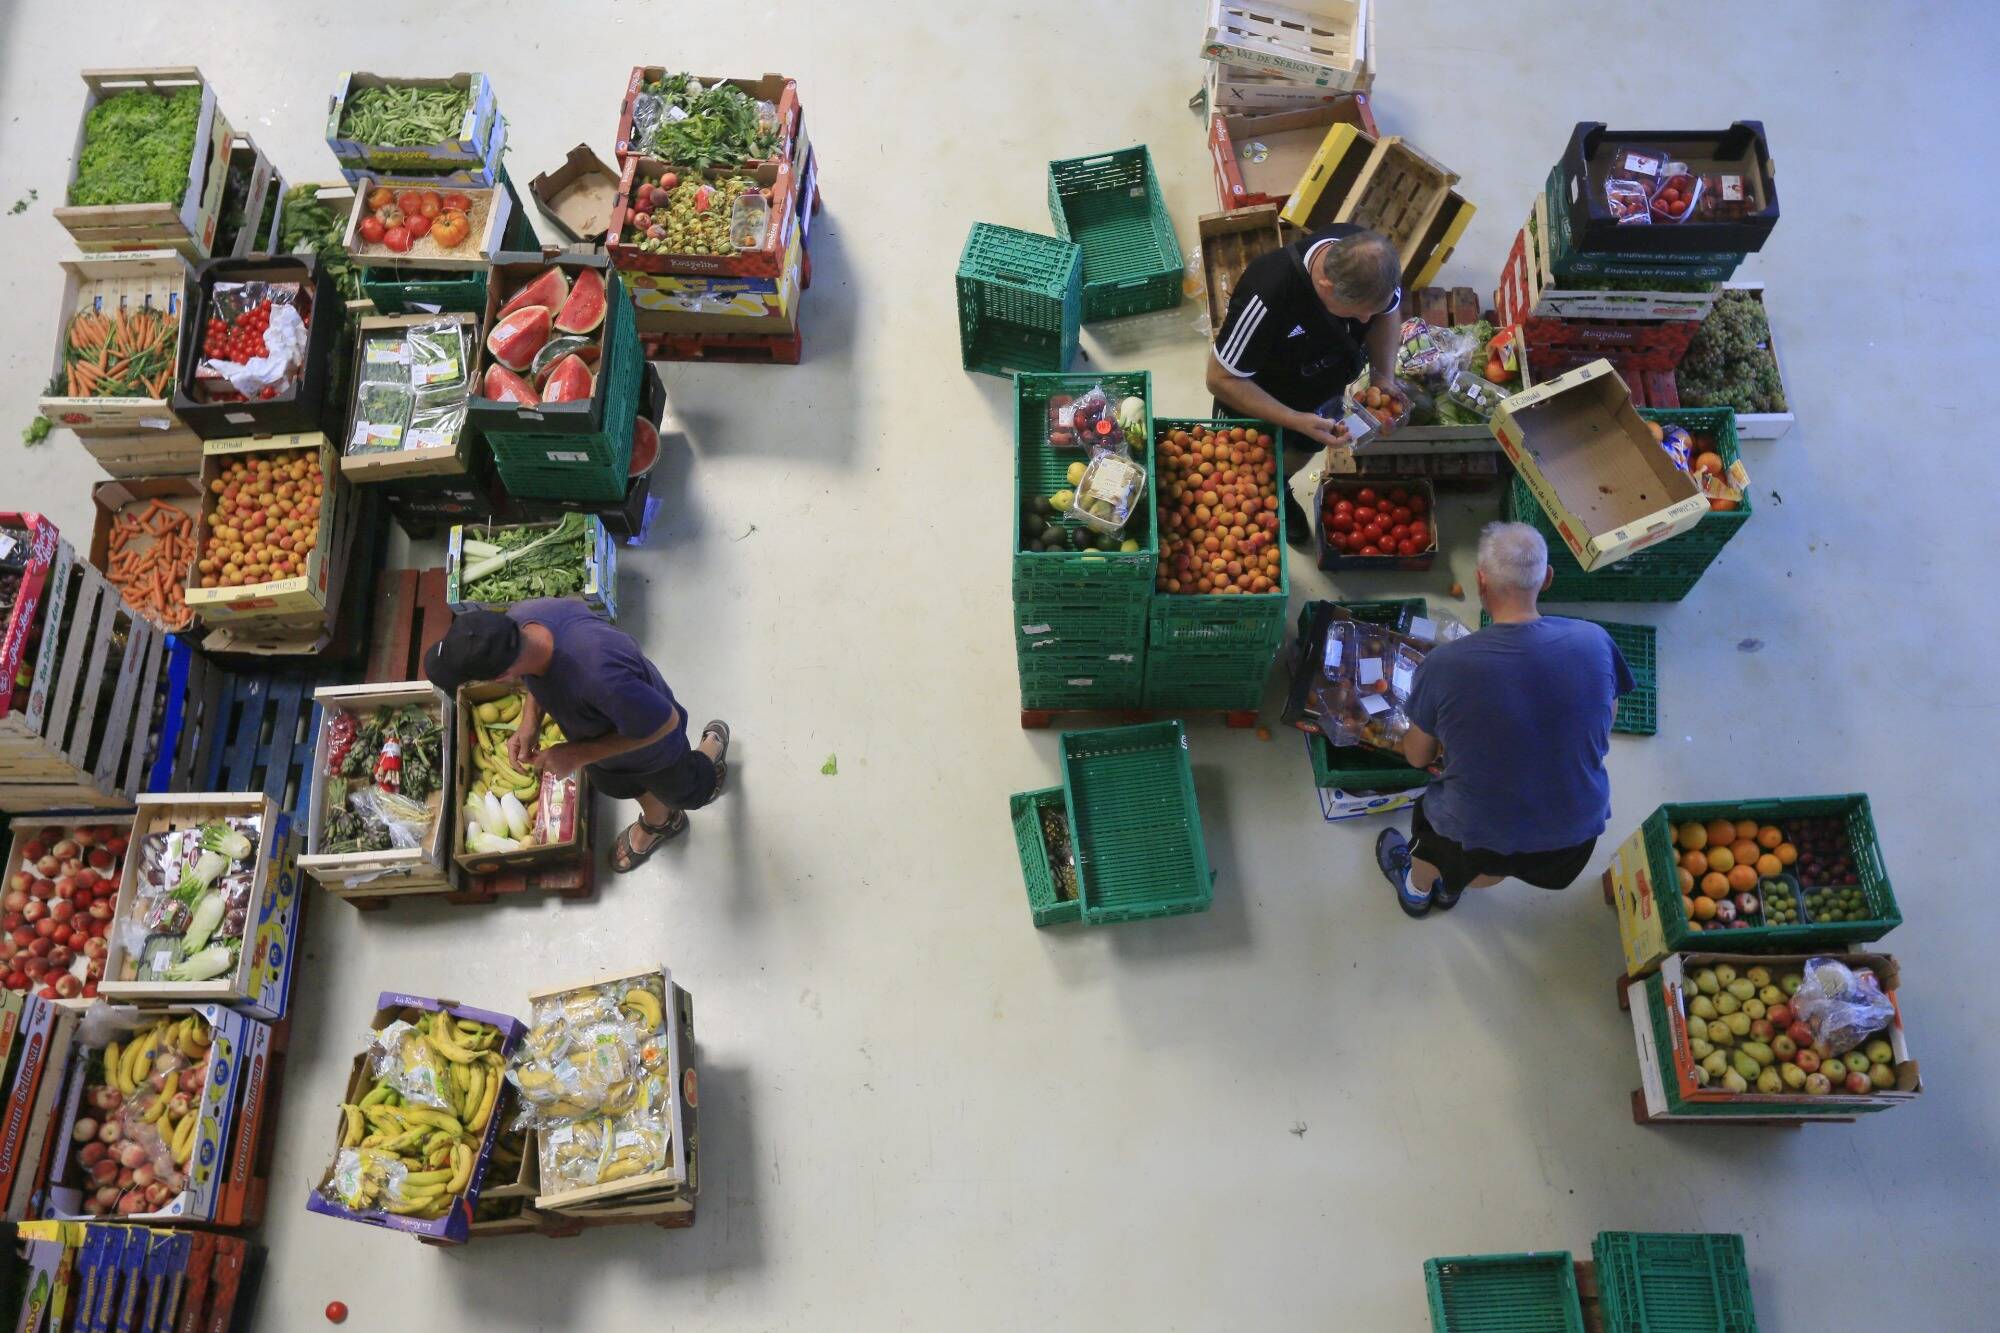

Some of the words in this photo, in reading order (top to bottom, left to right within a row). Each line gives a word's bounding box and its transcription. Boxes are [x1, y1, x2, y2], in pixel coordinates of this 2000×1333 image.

[1236, 48, 1255, 62] VAL
[1256, 54, 1270, 64] DE
[1604, 267, 1640, 276] Endives
[1653, 269, 1687, 277] France
[9, 629, 22, 666] Pink
[18, 597, 36, 632] Lady
[0, 1107, 23, 1173] Giovanni
[235, 1123, 252, 1183] Giovanni
